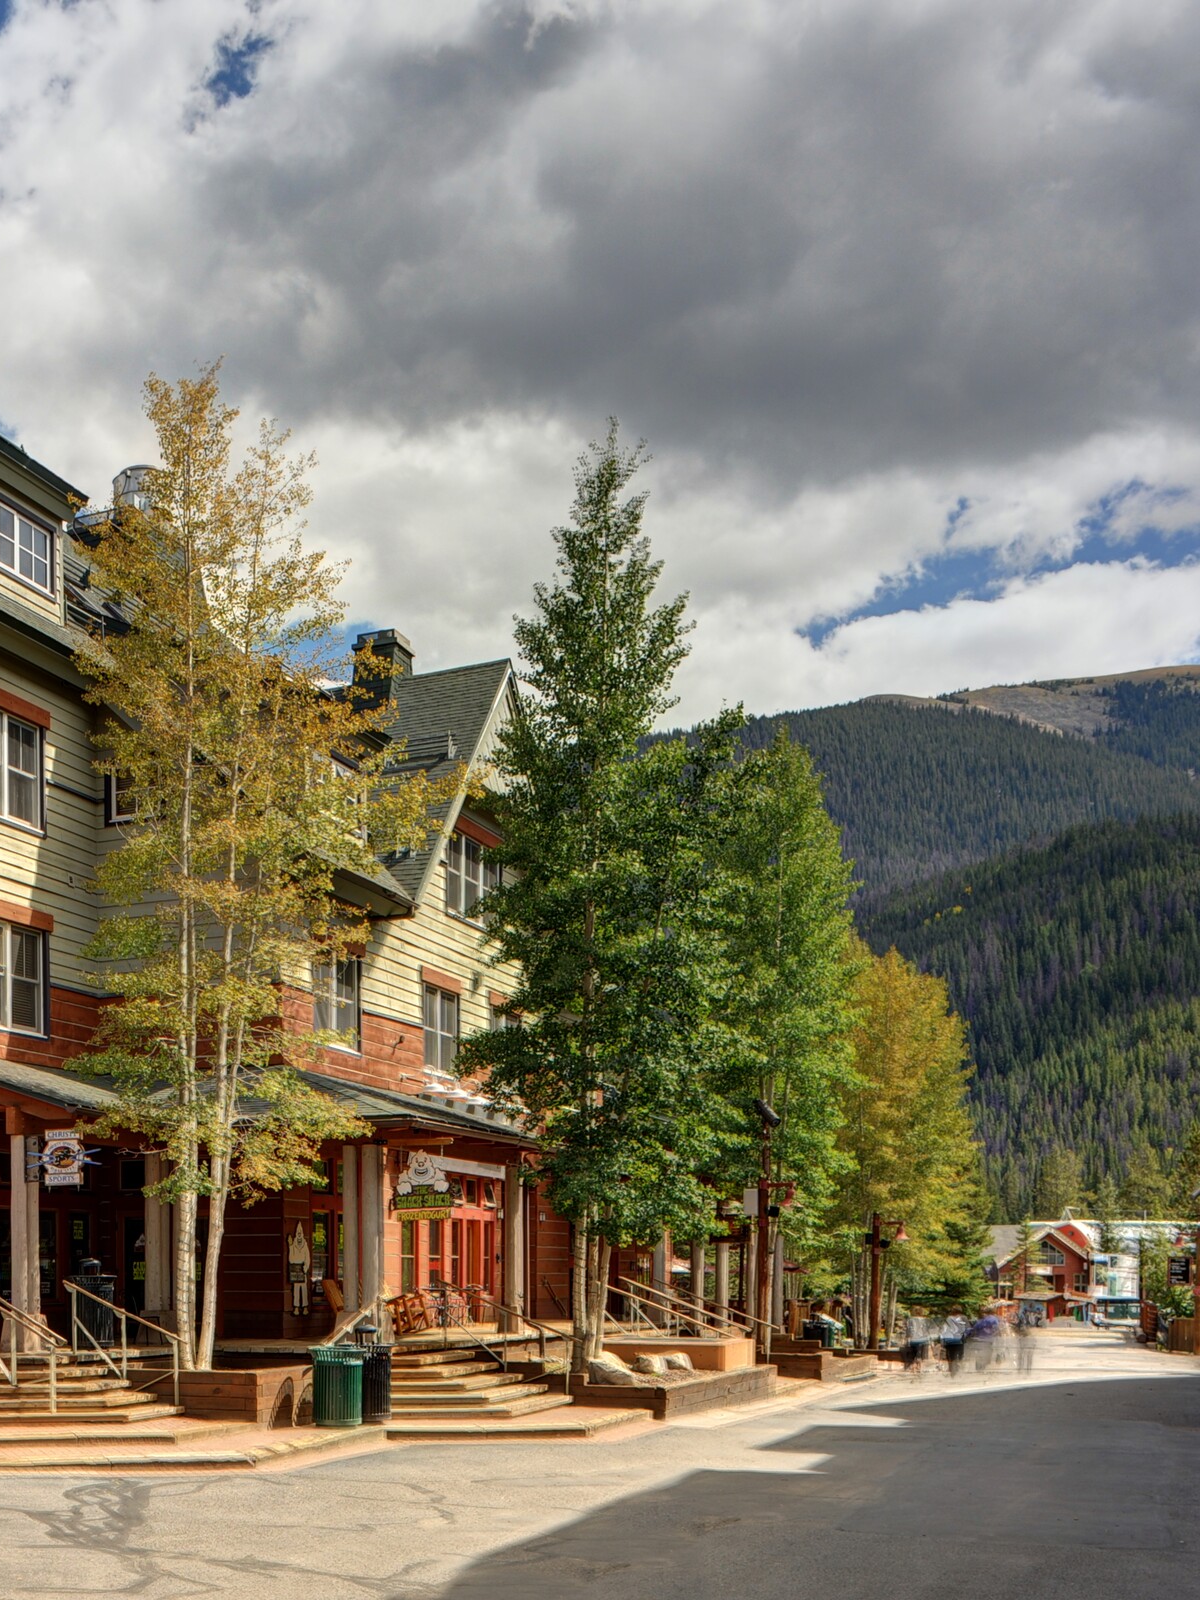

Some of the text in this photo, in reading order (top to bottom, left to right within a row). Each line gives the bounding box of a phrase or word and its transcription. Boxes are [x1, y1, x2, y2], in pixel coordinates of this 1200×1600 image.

[48, 1175, 75, 1183] SPORTS
[397, 1193, 450, 1208] SNACK SHACK
